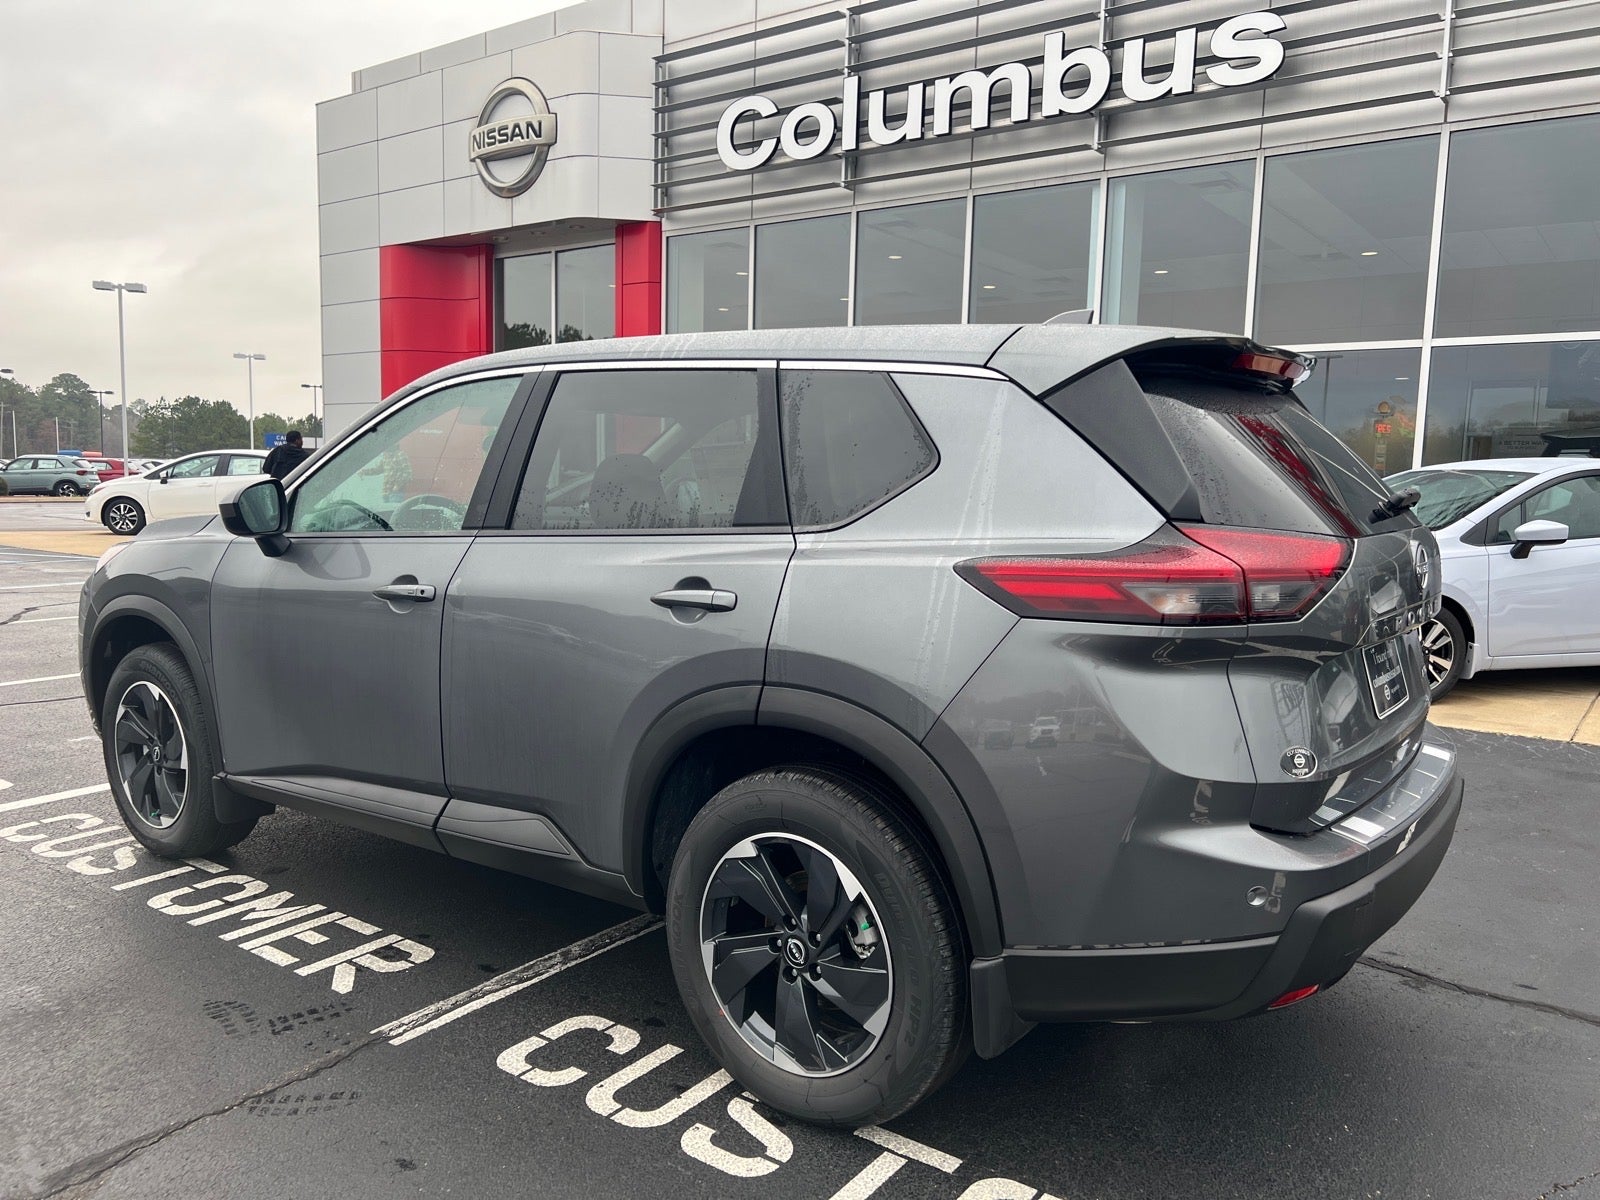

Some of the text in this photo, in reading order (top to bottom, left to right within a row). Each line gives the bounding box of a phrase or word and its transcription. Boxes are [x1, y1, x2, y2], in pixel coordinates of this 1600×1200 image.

[471, 119, 542, 153] NISSAN
[716, 9, 1286, 172] Columbus
[0, 813, 436, 994] CUSTOMER
